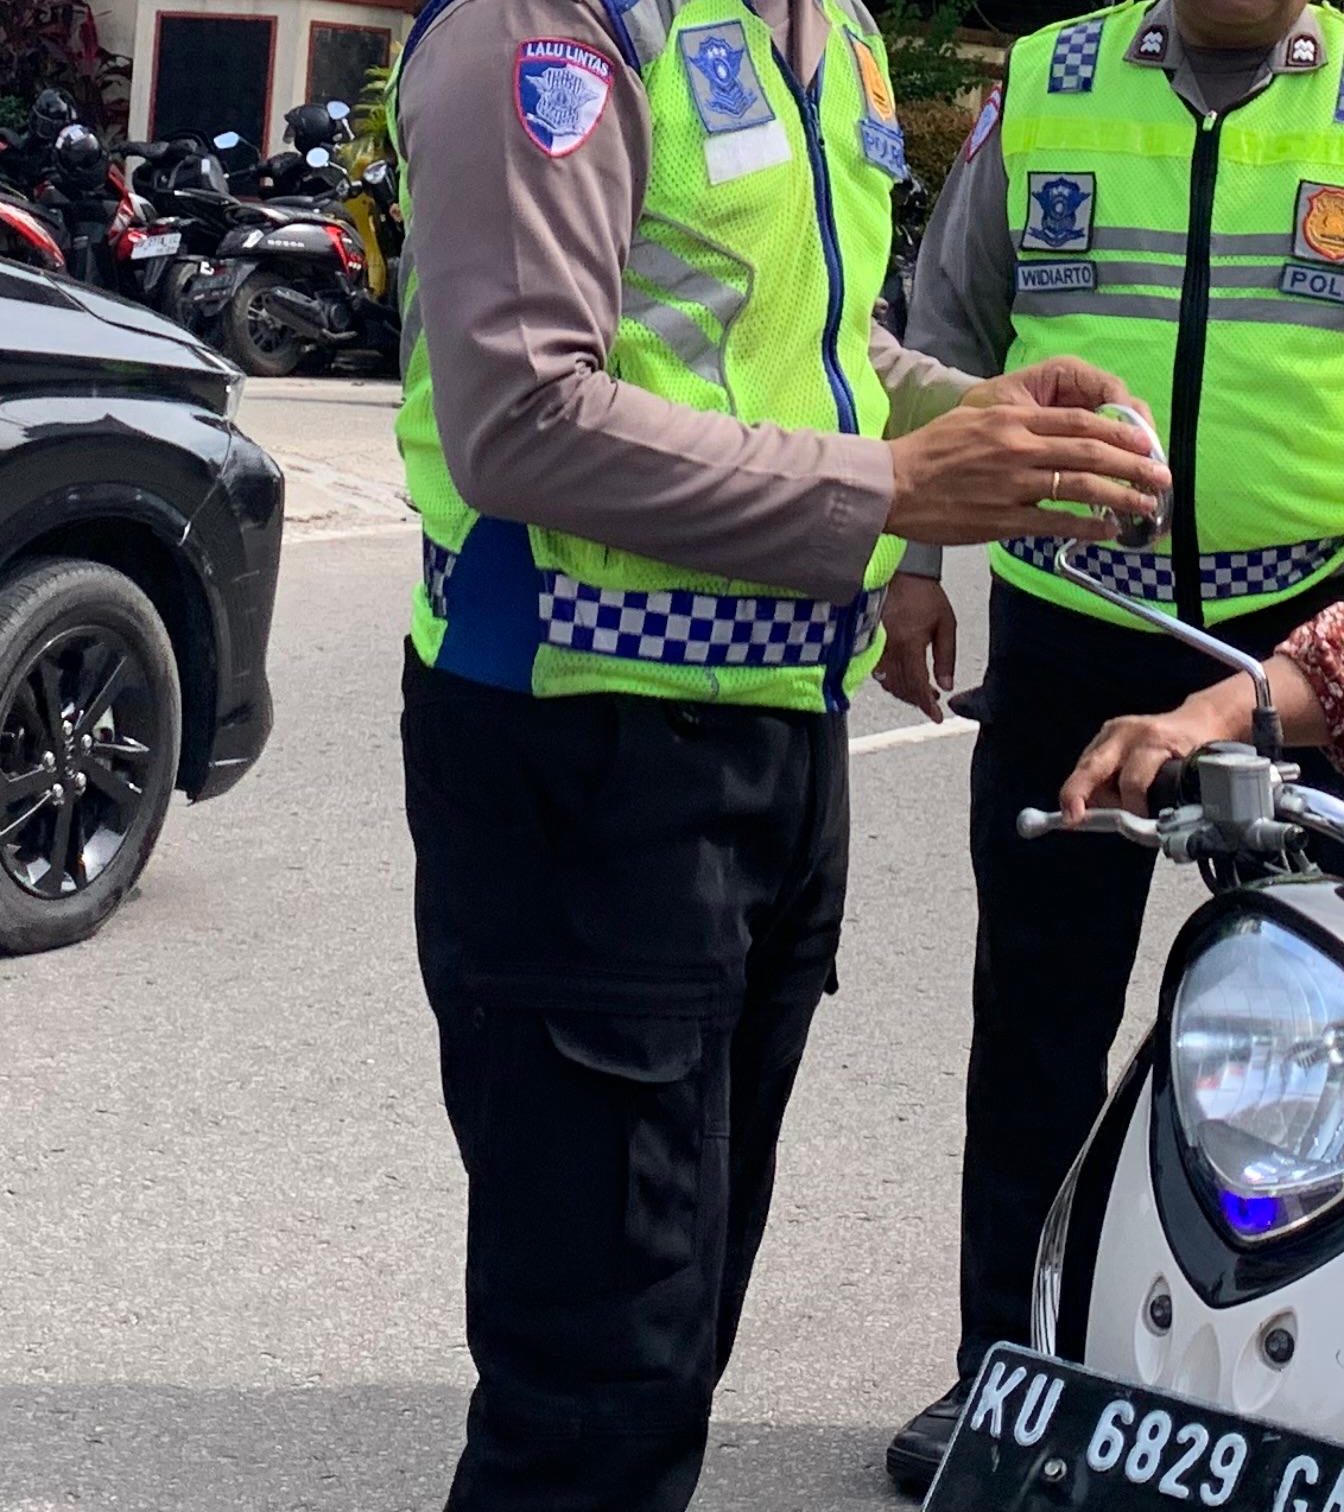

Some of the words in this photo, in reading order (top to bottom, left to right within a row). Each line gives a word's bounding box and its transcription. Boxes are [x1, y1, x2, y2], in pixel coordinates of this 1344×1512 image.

[526, 42, 564, 57] LALU
[566, 45, 609, 76] LINTAS
[1021, 266, 1092, 286] WIDIARTO
[970, 1361, 1065, 1446] KU
[1086, 1399, 1249, 1507] 6829
